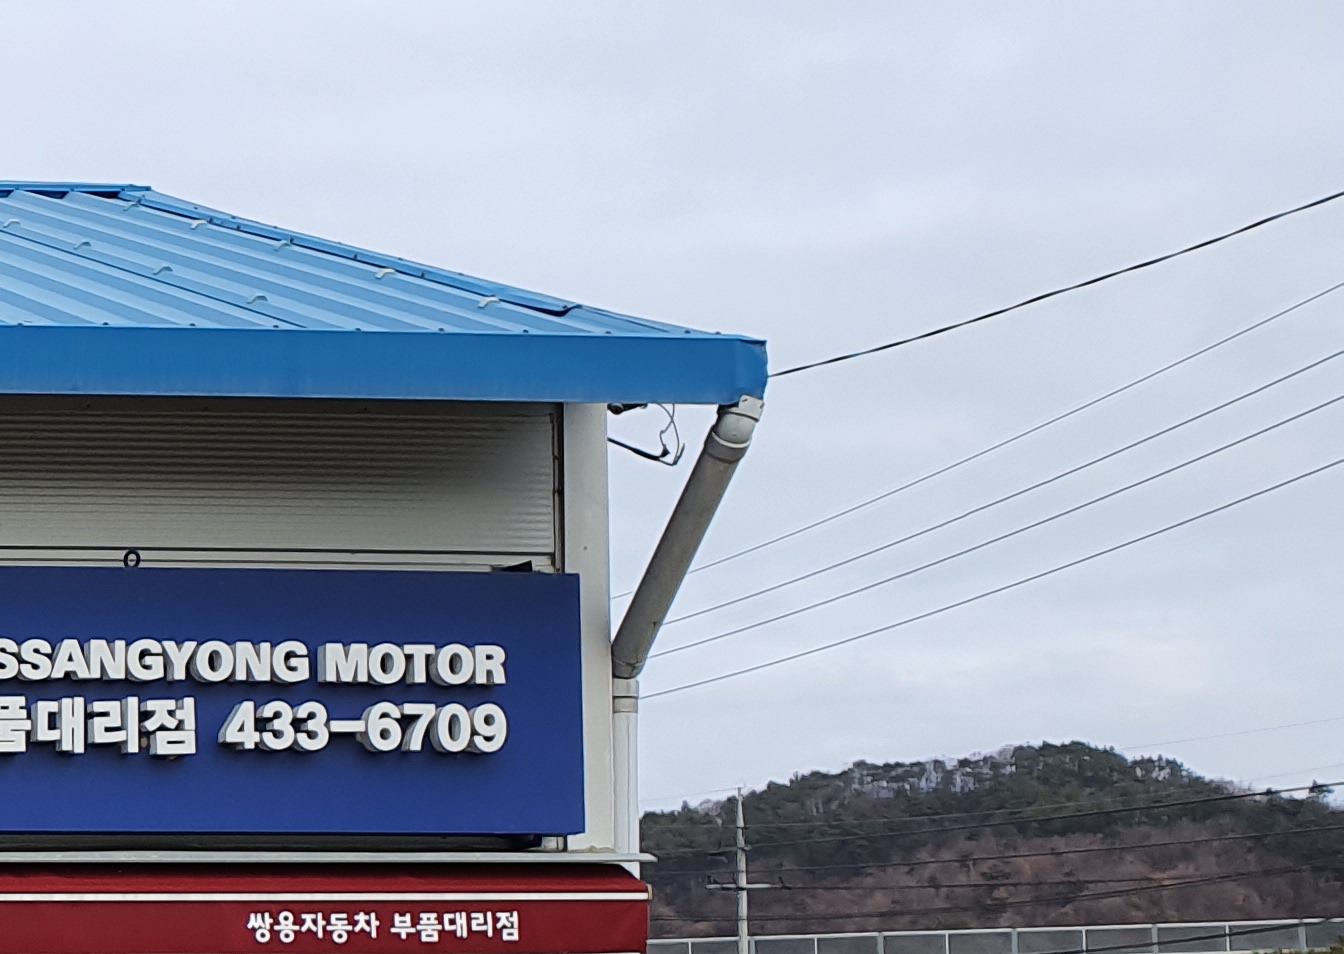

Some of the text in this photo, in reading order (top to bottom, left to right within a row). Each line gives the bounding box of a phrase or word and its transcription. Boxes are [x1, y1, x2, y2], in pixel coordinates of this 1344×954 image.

[319, 642, 506, 685] MOTOR
[219, 701, 507, 753] 433-6709
[247, 911, 519, 943] 쌍용자동차 부품대리점
